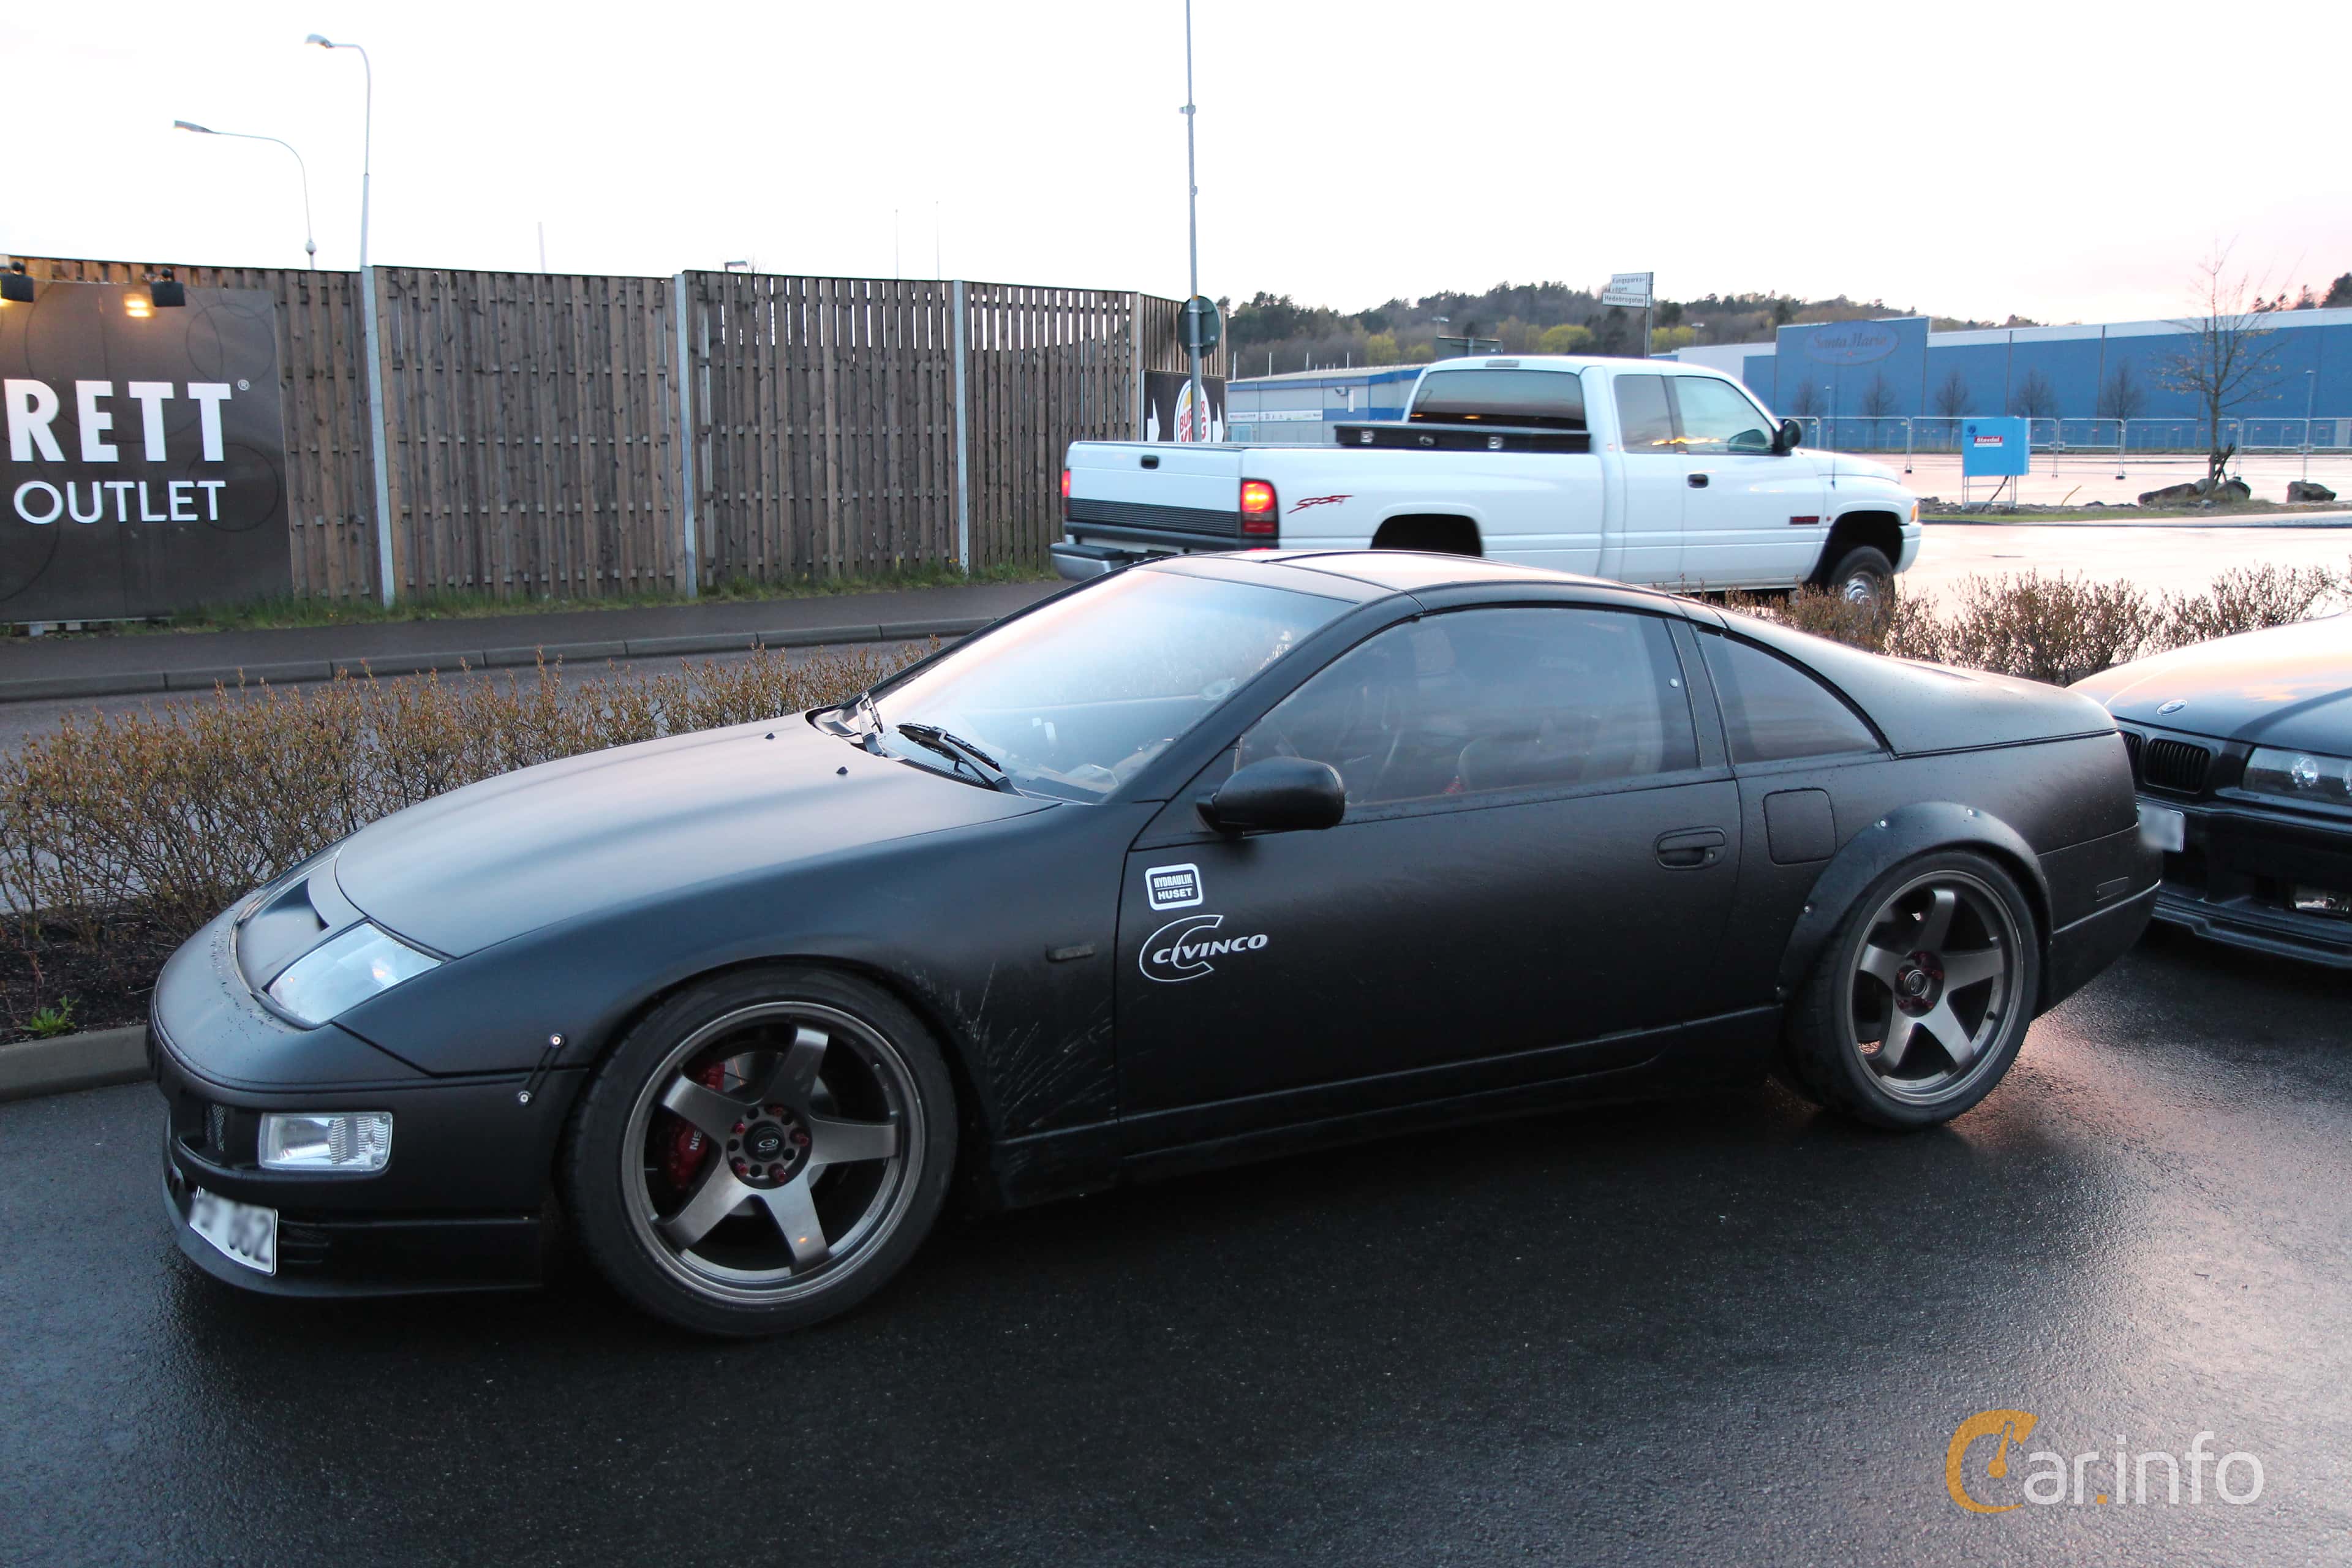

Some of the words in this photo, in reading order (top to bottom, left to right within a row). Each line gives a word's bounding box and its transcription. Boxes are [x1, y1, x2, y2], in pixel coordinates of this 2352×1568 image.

[1814, 333, 1847, 349] Santa
[1852, 332, 1887, 348] Maria
[13, 480, 227, 524] OUTLET
[1287, 495, 1353, 514] SPORT
[1153, 873, 1193, 888] HYDRAULIK
[1158, 888, 1193, 900] HUSET
[1152, 934, 1268, 964] CIVINCO
